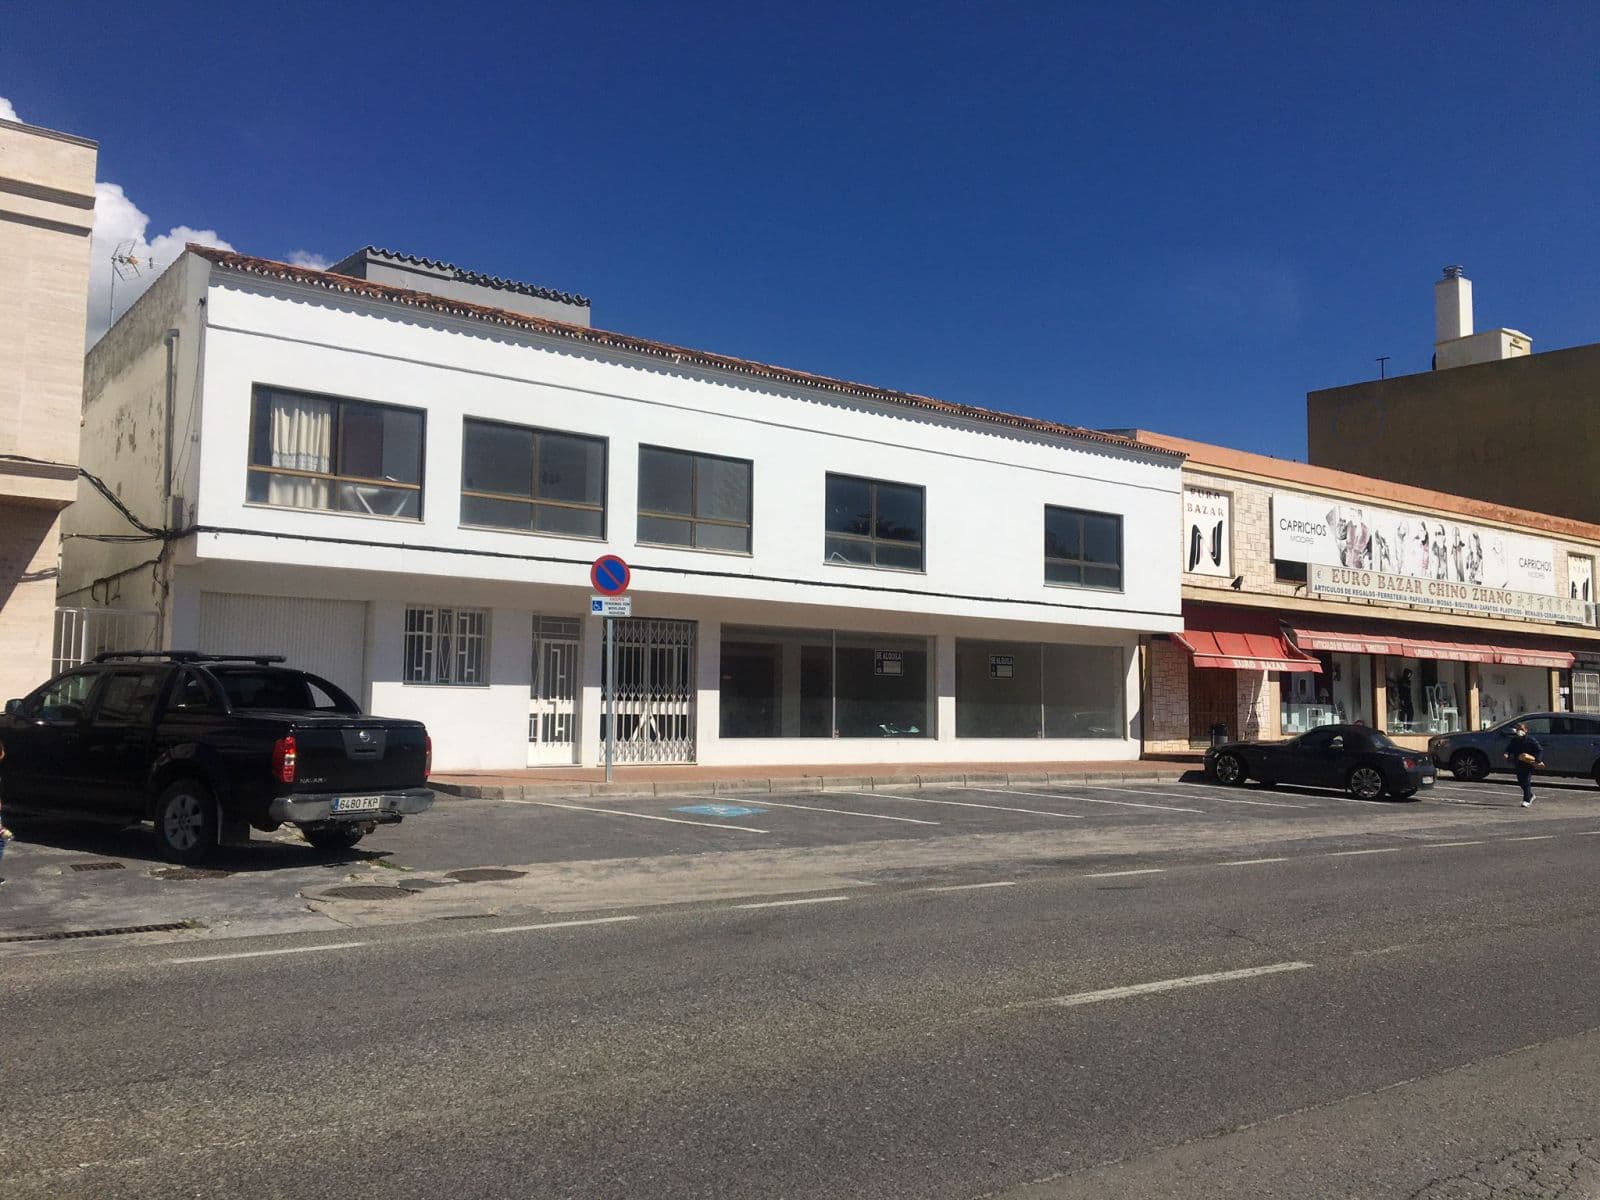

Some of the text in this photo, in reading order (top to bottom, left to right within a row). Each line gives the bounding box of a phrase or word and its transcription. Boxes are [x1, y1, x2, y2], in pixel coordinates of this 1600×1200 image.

[1187, 503, 1224, 517] BAZAR
[1279, 518, 1327, 537] CAPRICHOS
[1518, 557, 1552, 572] CAPRICHOS
[1314, 584, 1344, 594] ARTICULOS
[1352, 589, 1376, 597] REGALOS
[1331, 568, 1371, 587] EURO
[1377, 574, 1423, 594] BAZAR
[1428, 582, 1467, 600] CHINO
[1472, 588, 1513, 605] ZHANG
[362, 797, 379, 808] FKP
